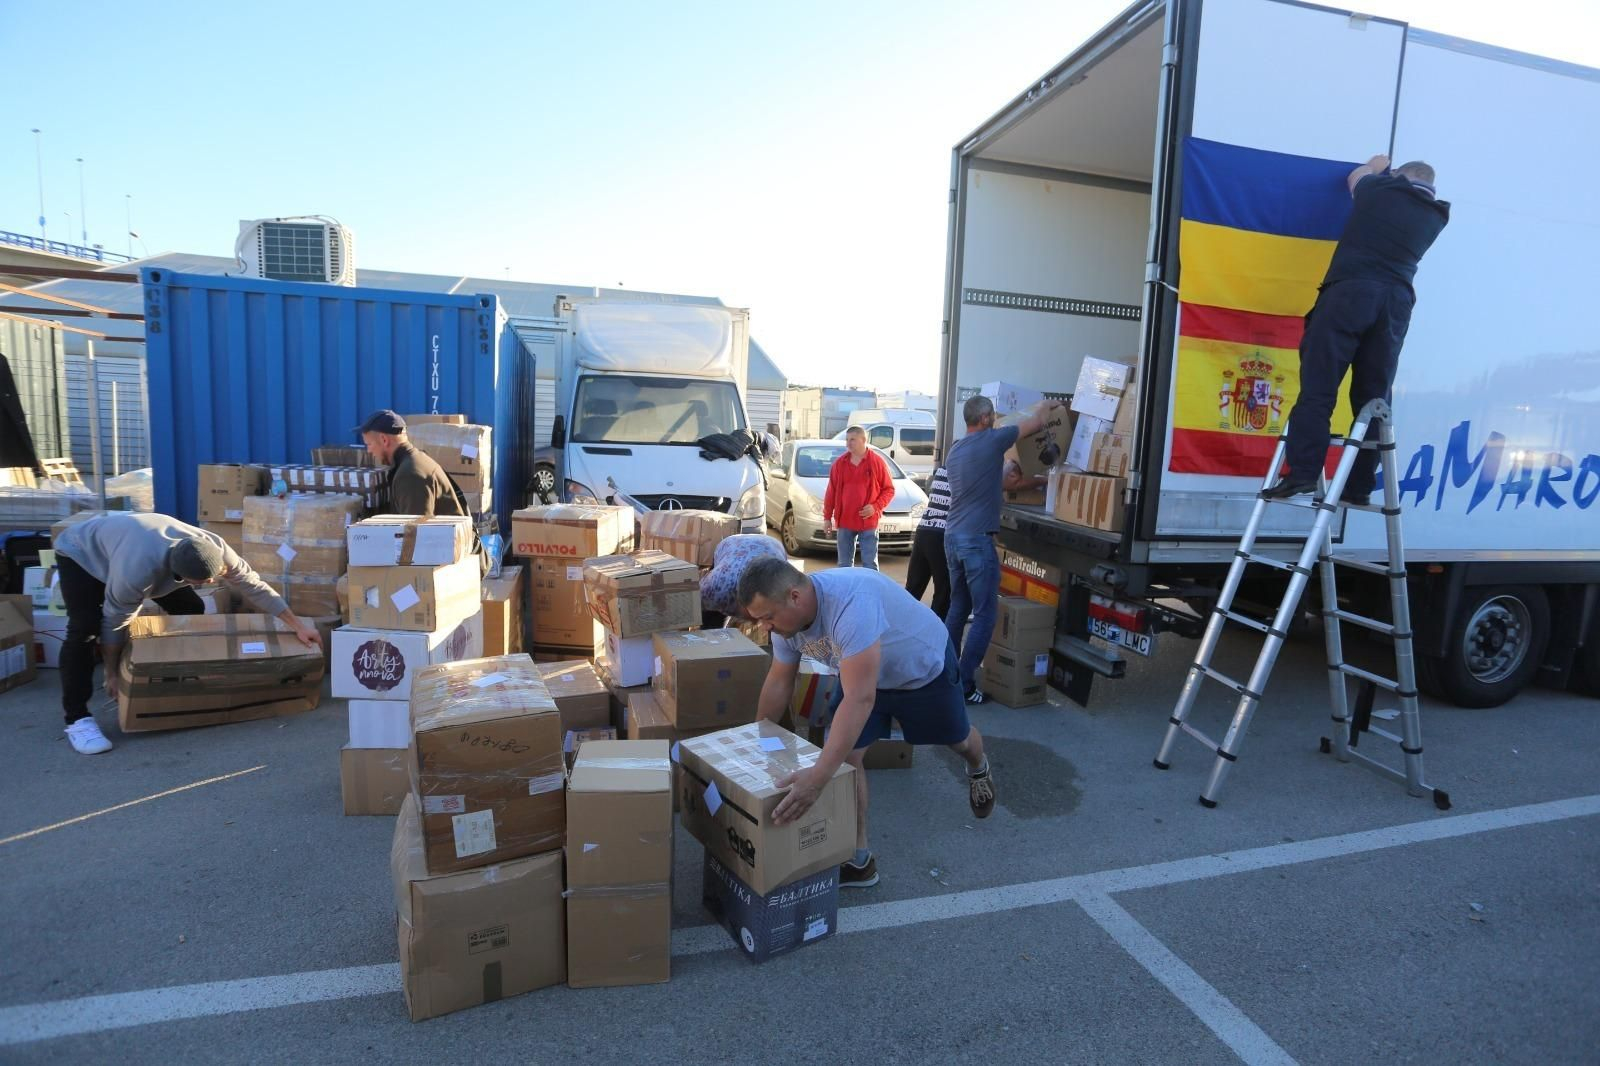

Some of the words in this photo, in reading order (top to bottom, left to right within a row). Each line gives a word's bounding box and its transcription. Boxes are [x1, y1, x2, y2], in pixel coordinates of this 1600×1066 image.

[518, 543, 577, 555] POLVILLO
[1124, 630, 1148, 652] LMC
[357, 643, 401, 673] Arty
[780, 878, 833, 904] БАЛТИКА
